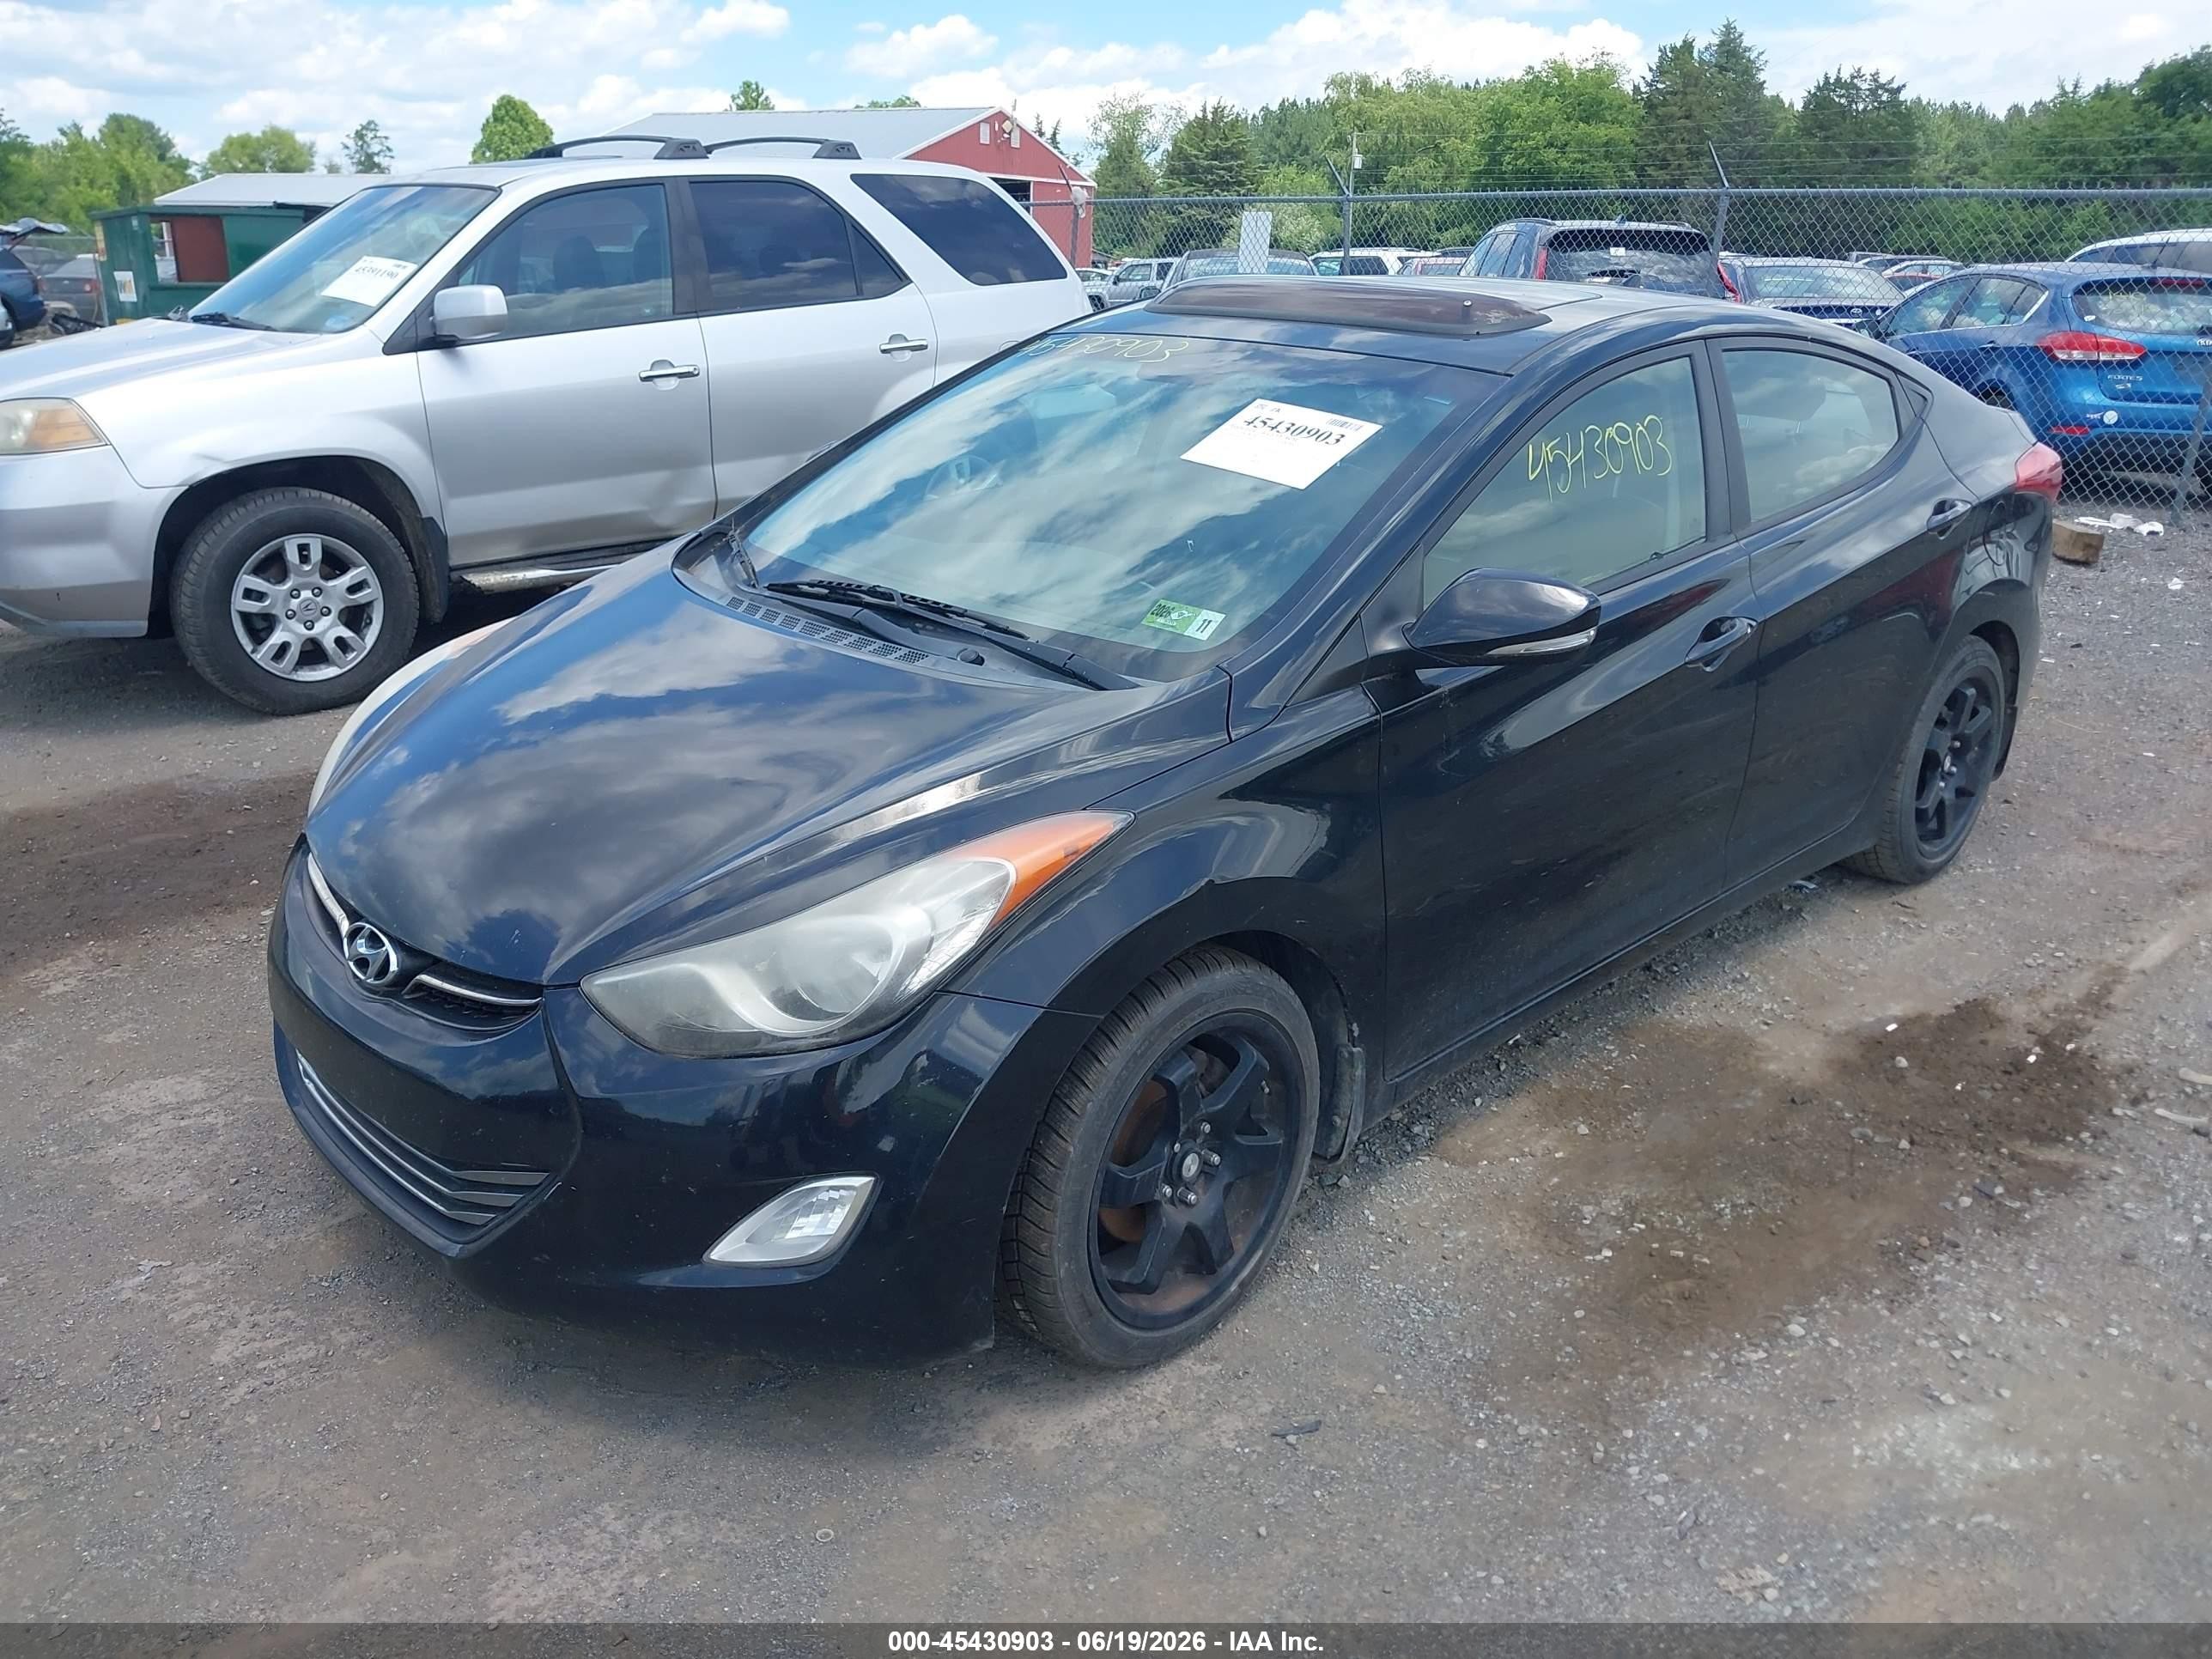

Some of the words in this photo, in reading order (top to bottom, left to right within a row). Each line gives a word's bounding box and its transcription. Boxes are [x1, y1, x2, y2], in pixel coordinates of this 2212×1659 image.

[1243, 415, 1346, 446] 45430903
[1528, 414, 1673, 502] 45430903
[1195, 618, 1212, 634] 11
